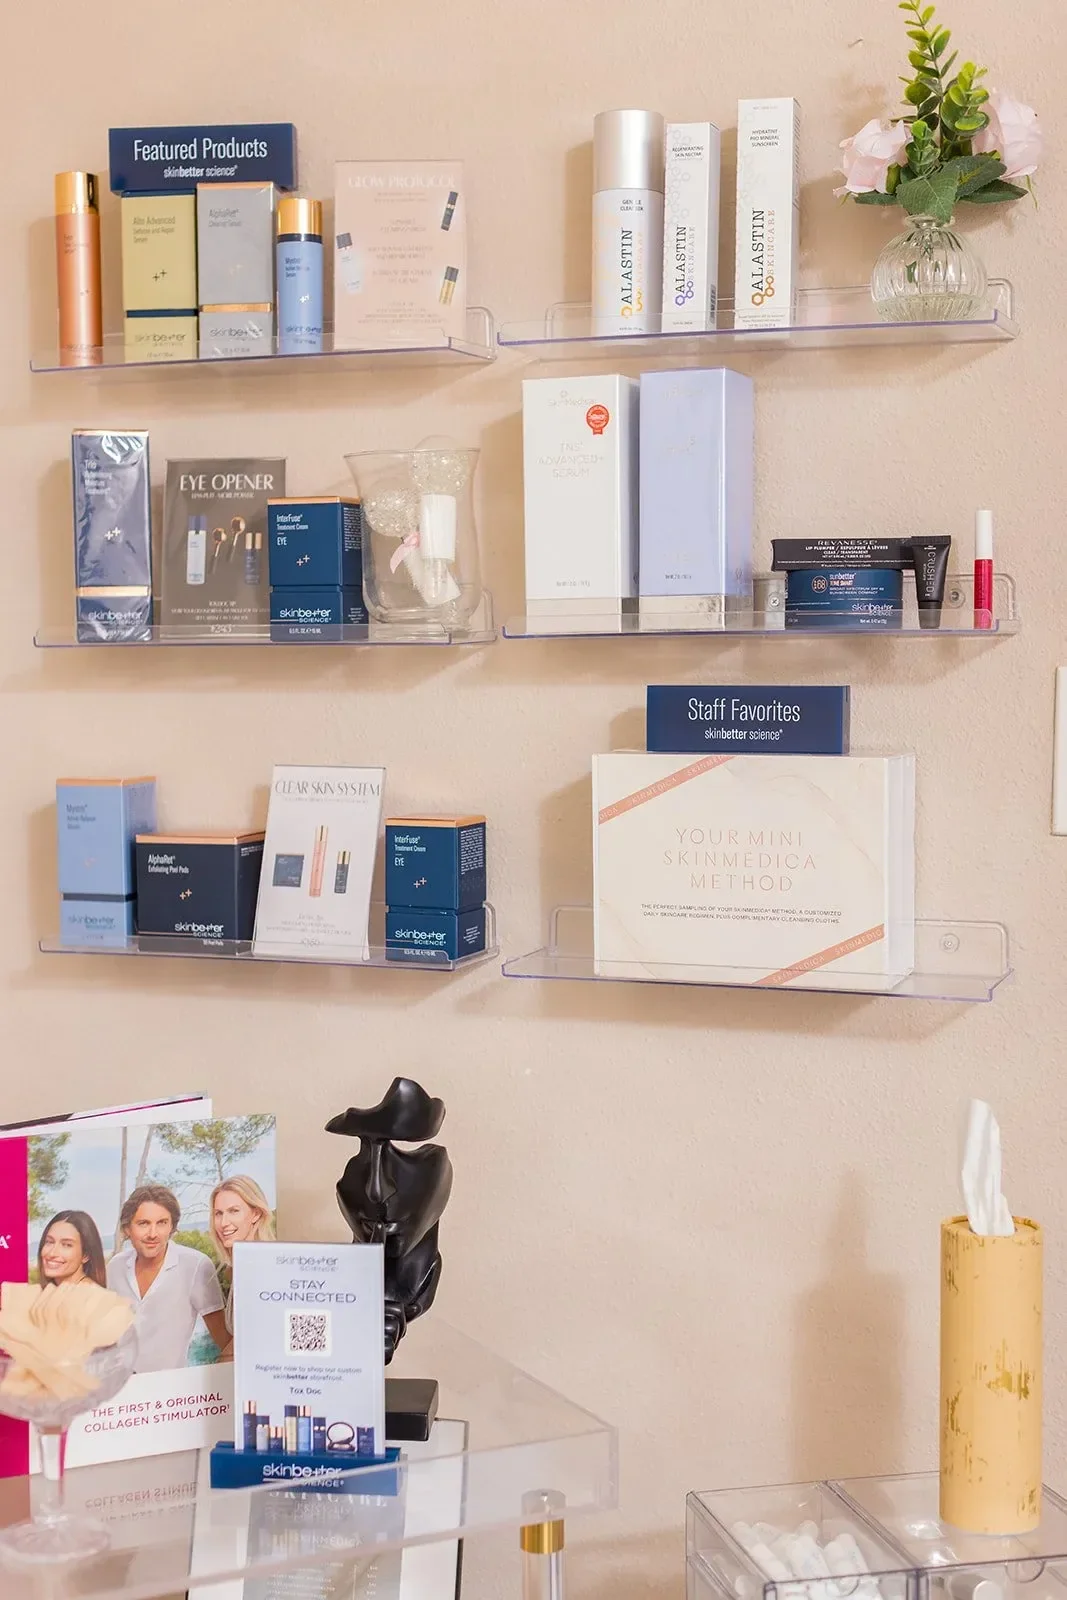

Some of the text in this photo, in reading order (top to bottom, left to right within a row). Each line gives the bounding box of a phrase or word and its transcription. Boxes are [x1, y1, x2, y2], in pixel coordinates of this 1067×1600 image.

[134, 136, 268, 161] Featured Products
[163, 165, 204, 179] skinbetter
[767, 209, 776, 275] SKINCARE
[751, 208, 765, 292] ALASTIN
[621, 228, 633, 305] ALASTIN
[675, 225, 687, 294] ALASTIN
[180, 474, 274, 491] EYE OPENER
[276, 536, 287, 546] EYE
[925, 551, 936, 593] CRUSHED
[279, 607, 332, 618] skinbetter
[852, 602, 894, 611] skinbetter
[88, 609, 142, 620] skinbetter
[688, 697, 801, 722] Staff Favorites
[704, 727, 748, 740] skinbetter
[275, 780, 380, 796] CLEAR SKIN SYSTEM
[394, 834, 420, 844] InterFuse
[676, 828, 802, 846] YOUR MINI
[148, 854, 175, 866] AlphaRet
[394, 857, 405, 867] EYE
[663, 849, 817, 870] SKINMEDICA
[690, 872, 793, 892] METHOD
[174, 922, 224, 932] skinbetter
[394, 928, 447, 940] skinbetter
[275, 1255, 339, 1266] skinbetter
[289, 1279, 326, 1290] STAY
[259, 1290, 357, 1304] CONNECTED
[255, 1364, 282, 1372] Register
[289, 1386, 322, 1395] Tox Doc
[91, 1391, 223, 1419] THE FIRST & ORIGINAL
[84, 1416, 149, 1433] COLLAGEN
